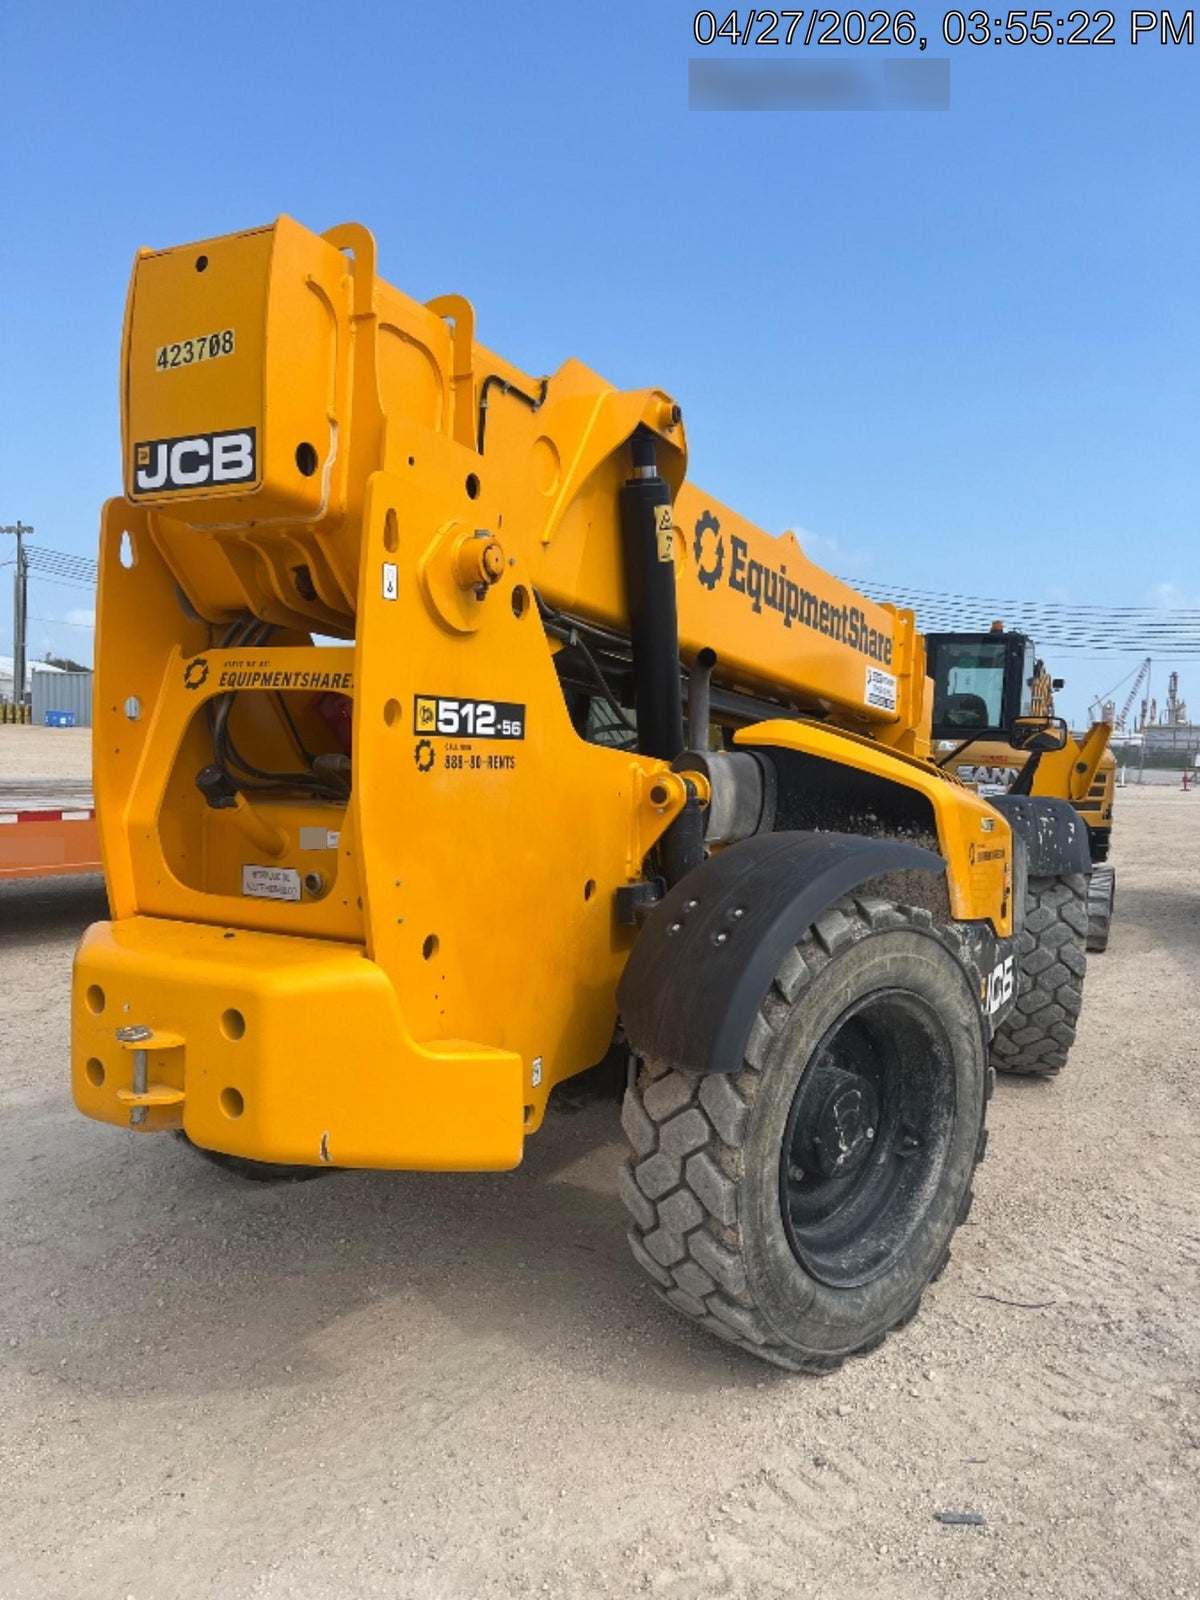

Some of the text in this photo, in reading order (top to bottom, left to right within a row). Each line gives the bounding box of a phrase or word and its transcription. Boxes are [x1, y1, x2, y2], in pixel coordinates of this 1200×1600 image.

[156, 330, 234, 369] 423708
[136, 433, 253, 490] JCB
[729, 534, 892, 665] EquipmentShare
